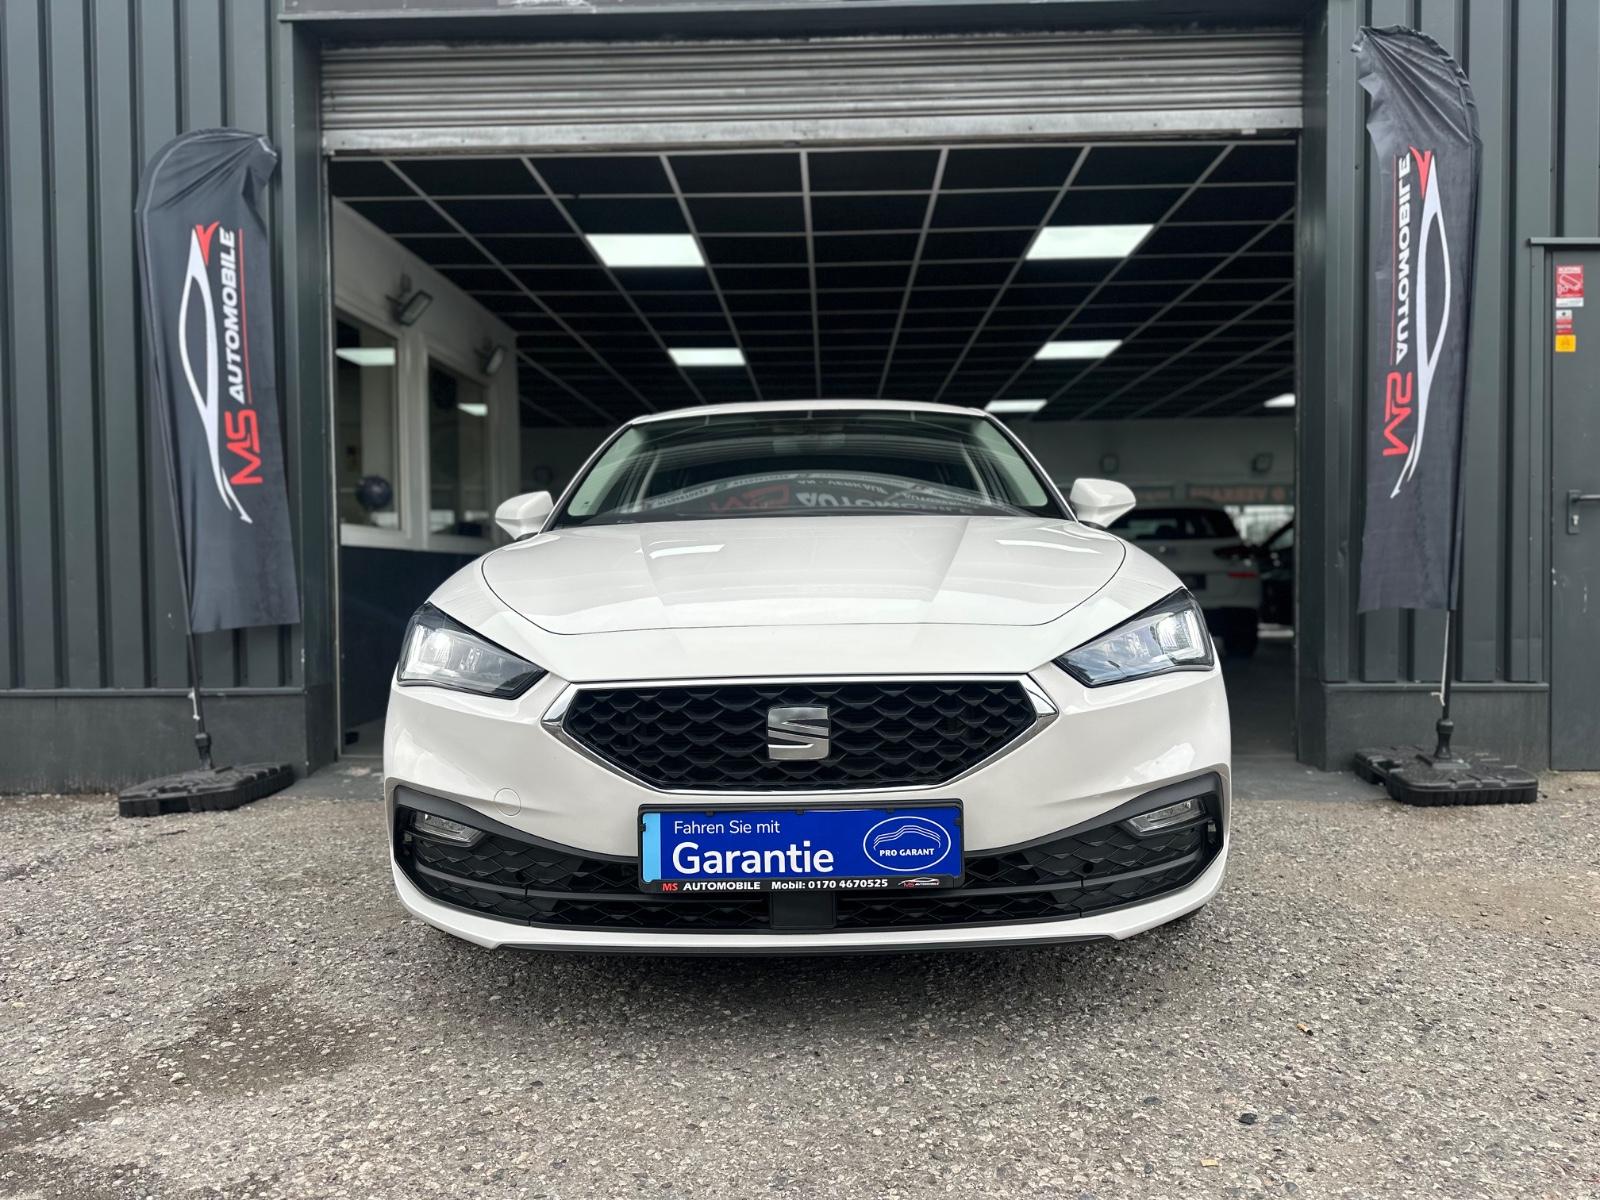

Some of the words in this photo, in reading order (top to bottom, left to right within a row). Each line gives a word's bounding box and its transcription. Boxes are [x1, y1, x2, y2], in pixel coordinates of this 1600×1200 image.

[219, 226, 246, 405] AUTOMOBILE
[224, 408, 263, 486] MS
[674, 820, 725, 834] Fahren
[729, 820, 751, 834] Sie
[756, 820, 780, 834] mit
[672, 840, 834, 875] Garantie
[879, 849, 897, 857] PRO
[899, 848, 935, 856] GARANT
[662, 883, 678, 892] MS
[683, 881, 761, 891] AUTOMOBILE
[771, 880, 806, 890] Mobil:
[808, 879, 836, 889] 0170
[838, 879, 888, 888] 4670525
